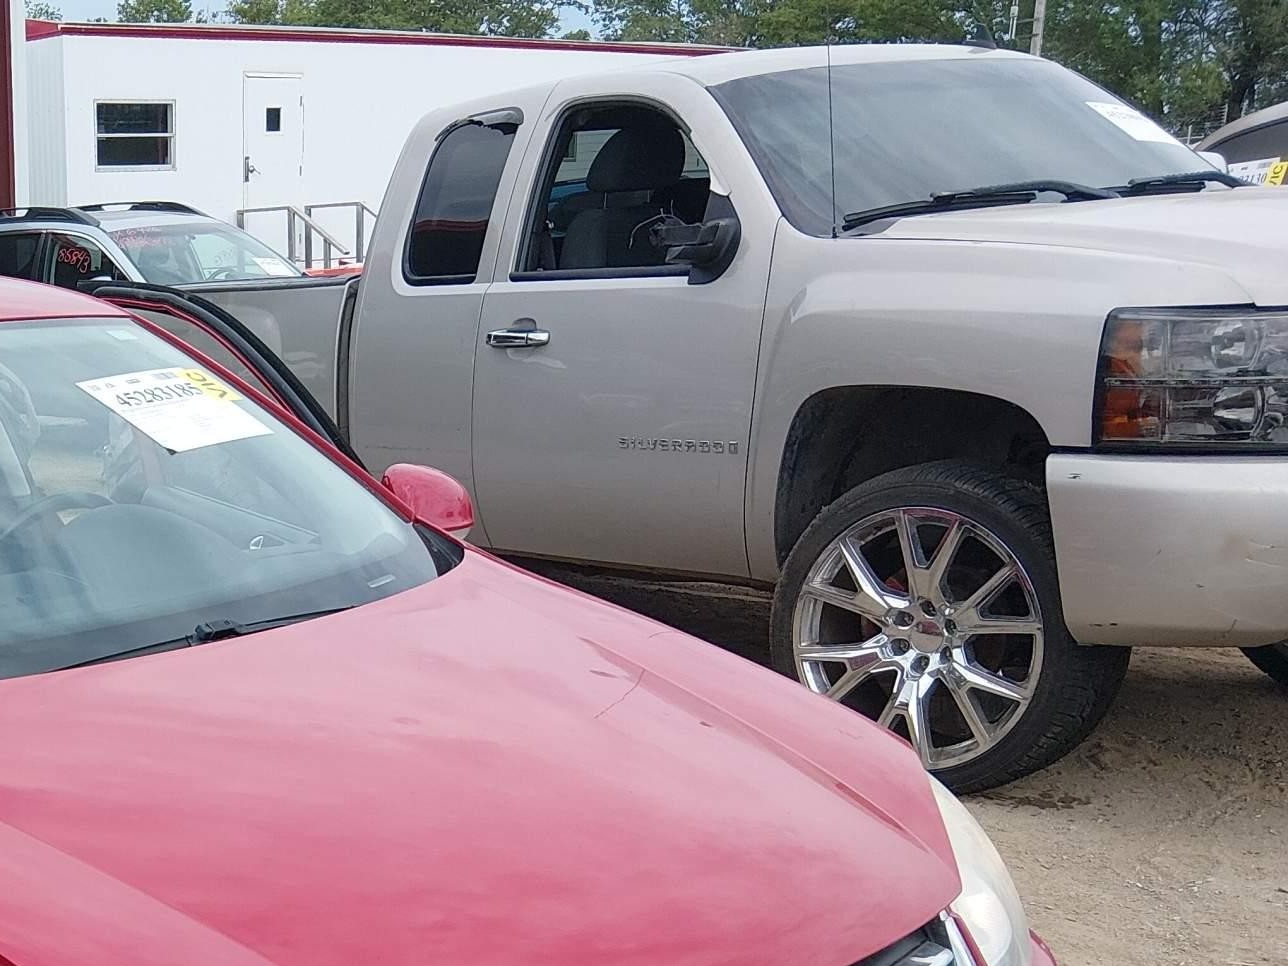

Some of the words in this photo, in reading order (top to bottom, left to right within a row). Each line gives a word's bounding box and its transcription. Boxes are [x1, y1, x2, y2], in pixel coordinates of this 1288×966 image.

[58, 248, 91, 273] 85843
[115, 382, 204, 407] 45283185
[618, 437, 724, 454] SILVERADO
